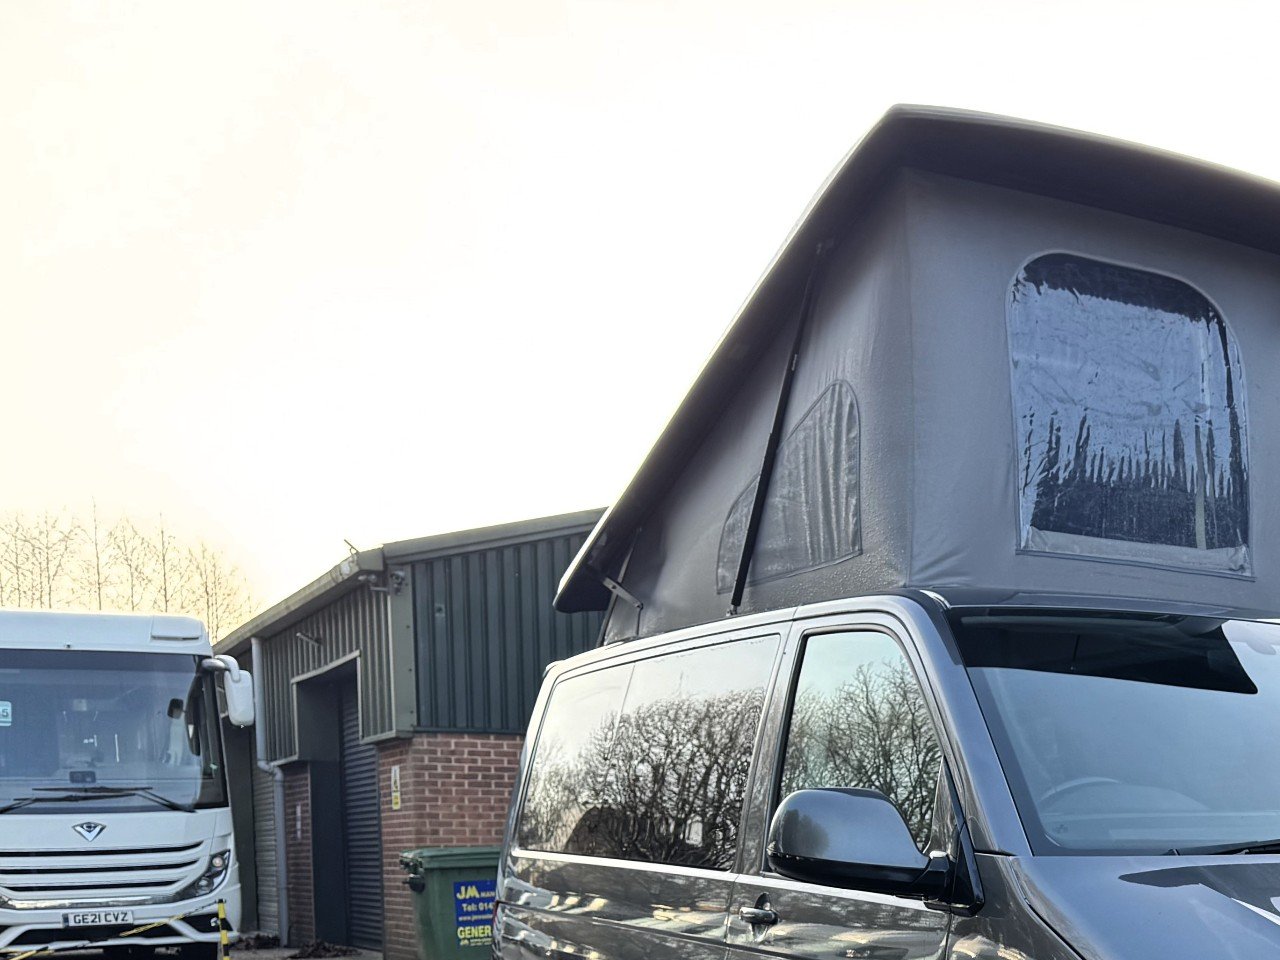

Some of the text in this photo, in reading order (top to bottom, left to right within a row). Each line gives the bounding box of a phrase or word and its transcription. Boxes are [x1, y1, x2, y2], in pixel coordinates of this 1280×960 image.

[456, 885, 480, 899] JM
[73, 911, 129, 924] GE21 CVZ
[457, 925, 493, 939] GENER
